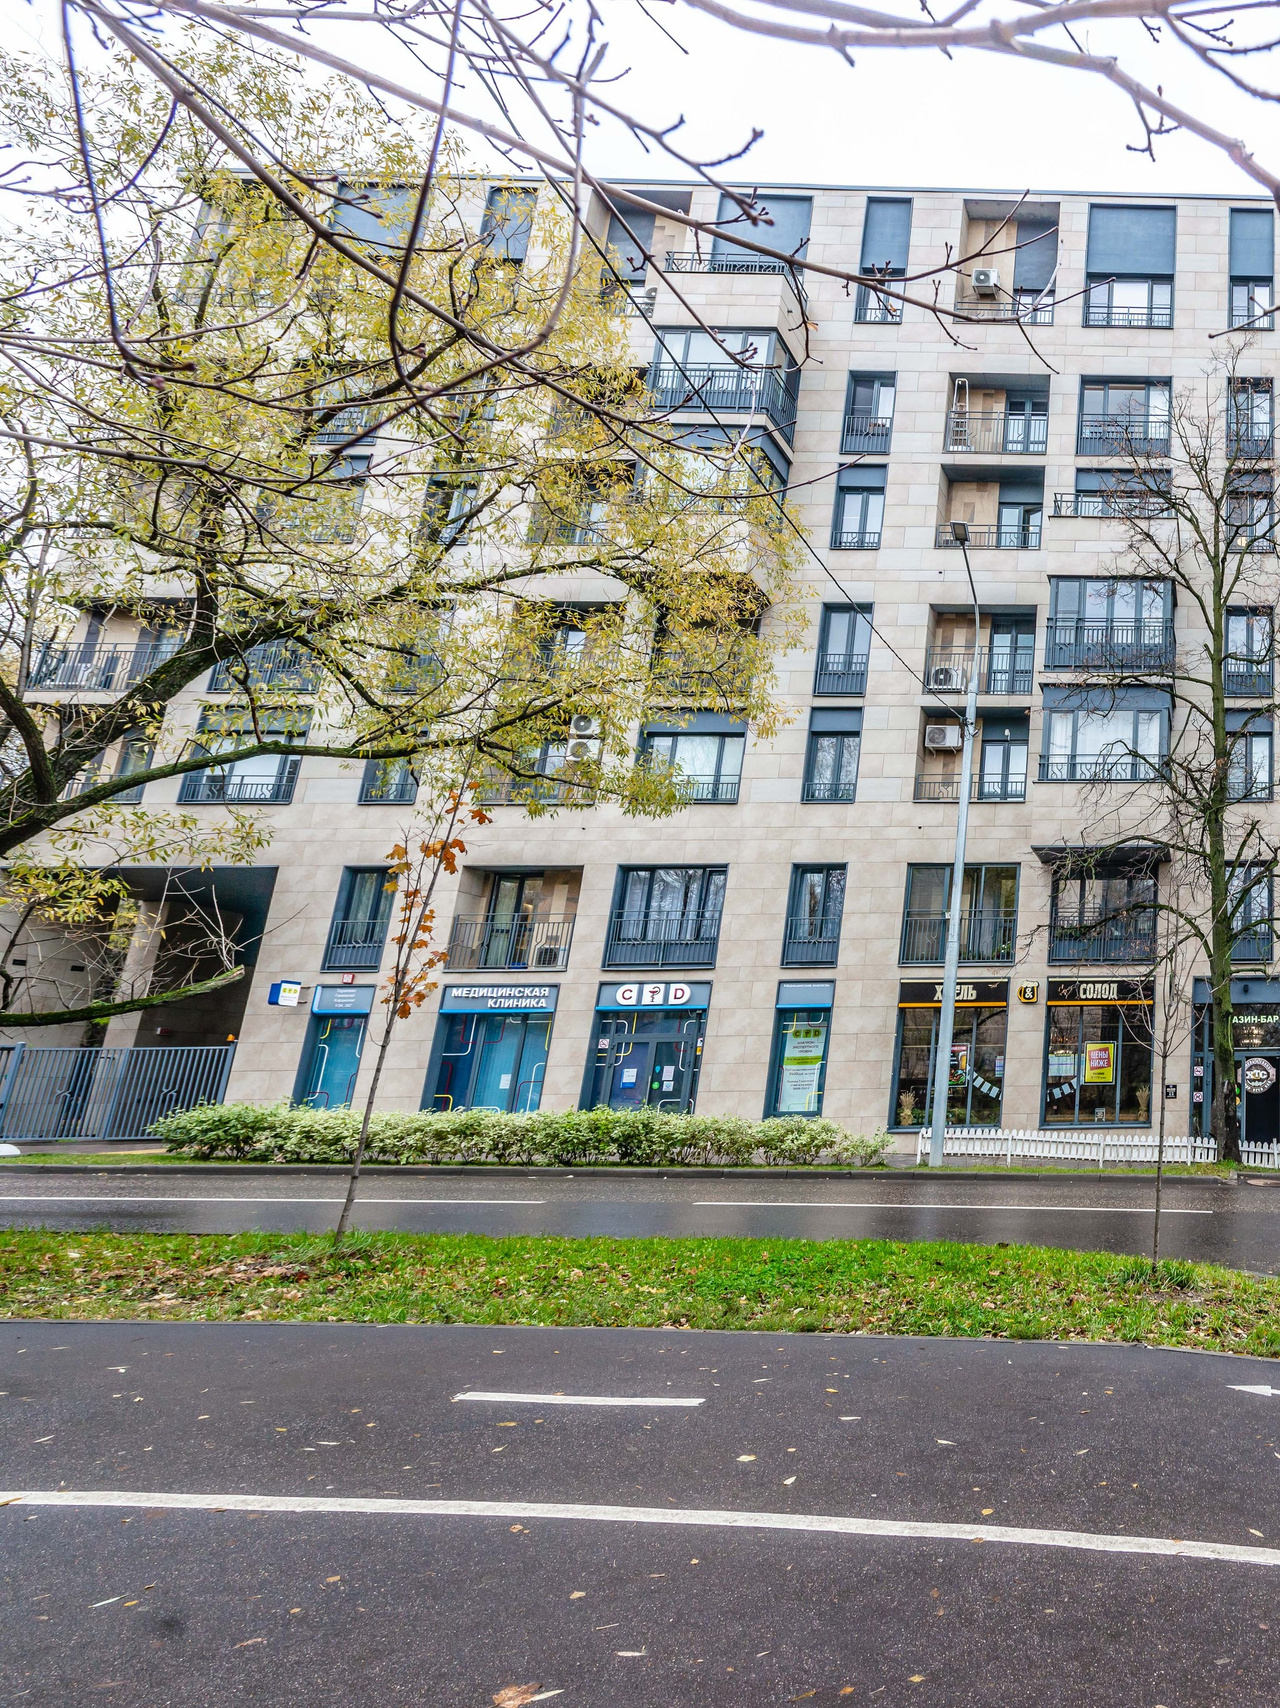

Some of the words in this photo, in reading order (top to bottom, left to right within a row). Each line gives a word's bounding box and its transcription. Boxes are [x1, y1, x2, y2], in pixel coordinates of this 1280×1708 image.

[451, 987, 550, 998] МЕДИЦИНСКАЯ
[933, 984, 977, 1000] ХЕЛЬ
[1079, 983, 1119, 1000] СОЛОД
[487, 998, 547, 1008] КЛИНИКА
[1231, 1015, 1280, 1024] АЗИН-БАР
[1090, 1050, 1109, 1060] ЦЕНЫ
[1090, 1059, 1108, 1068] НИЖЕ
